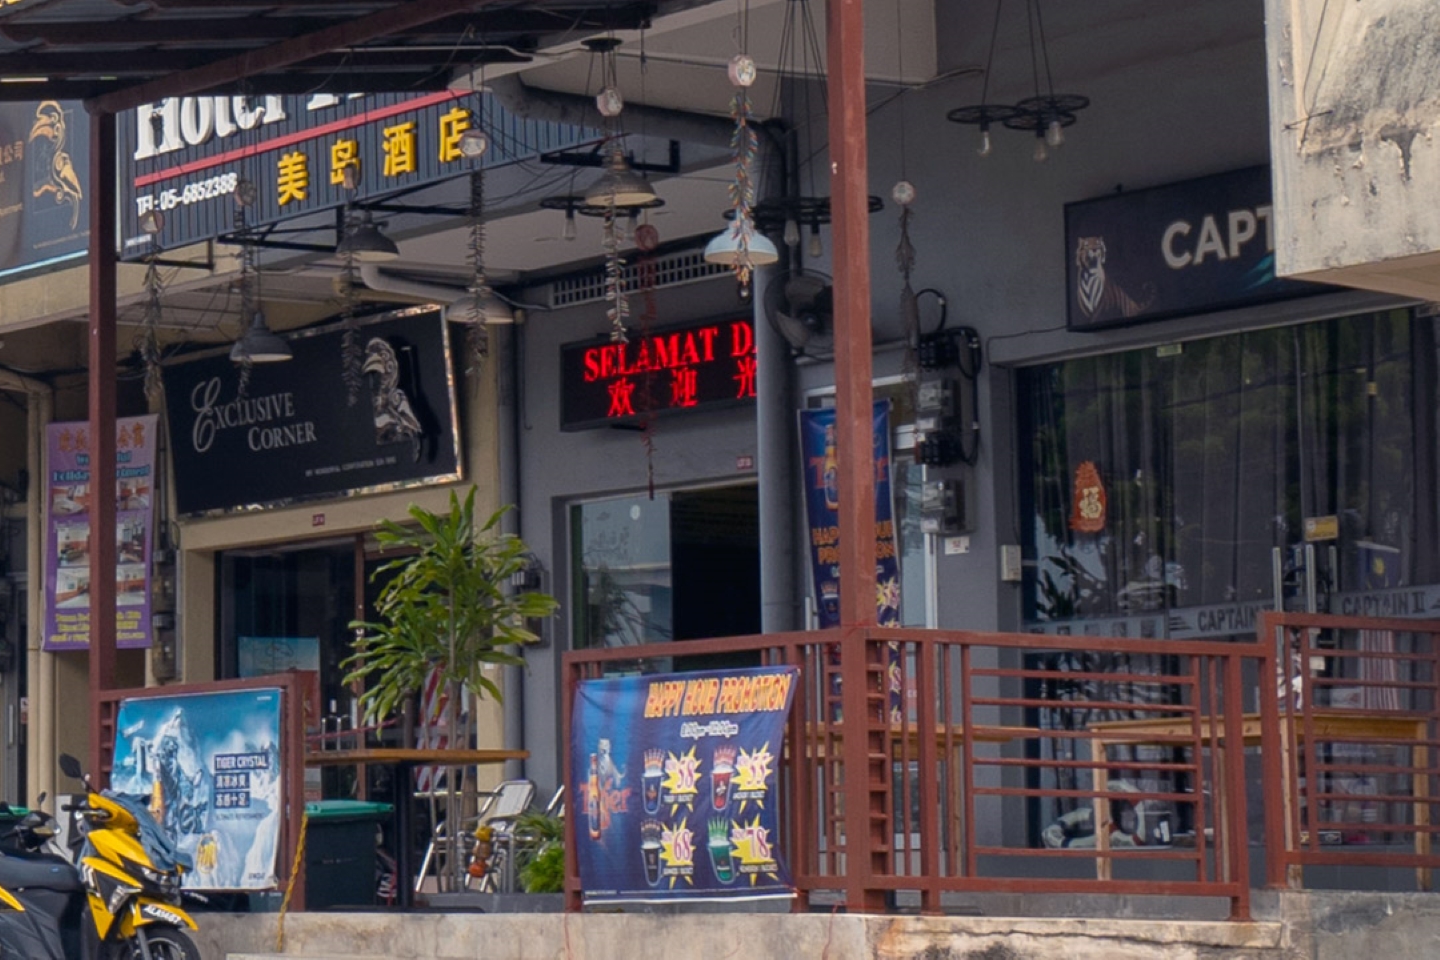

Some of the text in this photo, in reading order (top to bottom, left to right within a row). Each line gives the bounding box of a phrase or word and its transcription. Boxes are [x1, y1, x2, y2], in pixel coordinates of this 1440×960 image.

[583, 320, 758, 382] SELAMAT D
[644, 673, 793, 718] HAPPY HOUR PROMOTION
[216, 755, 267, 769] TIGER CRYSTAL
[673, 830, 691, 862] 68
